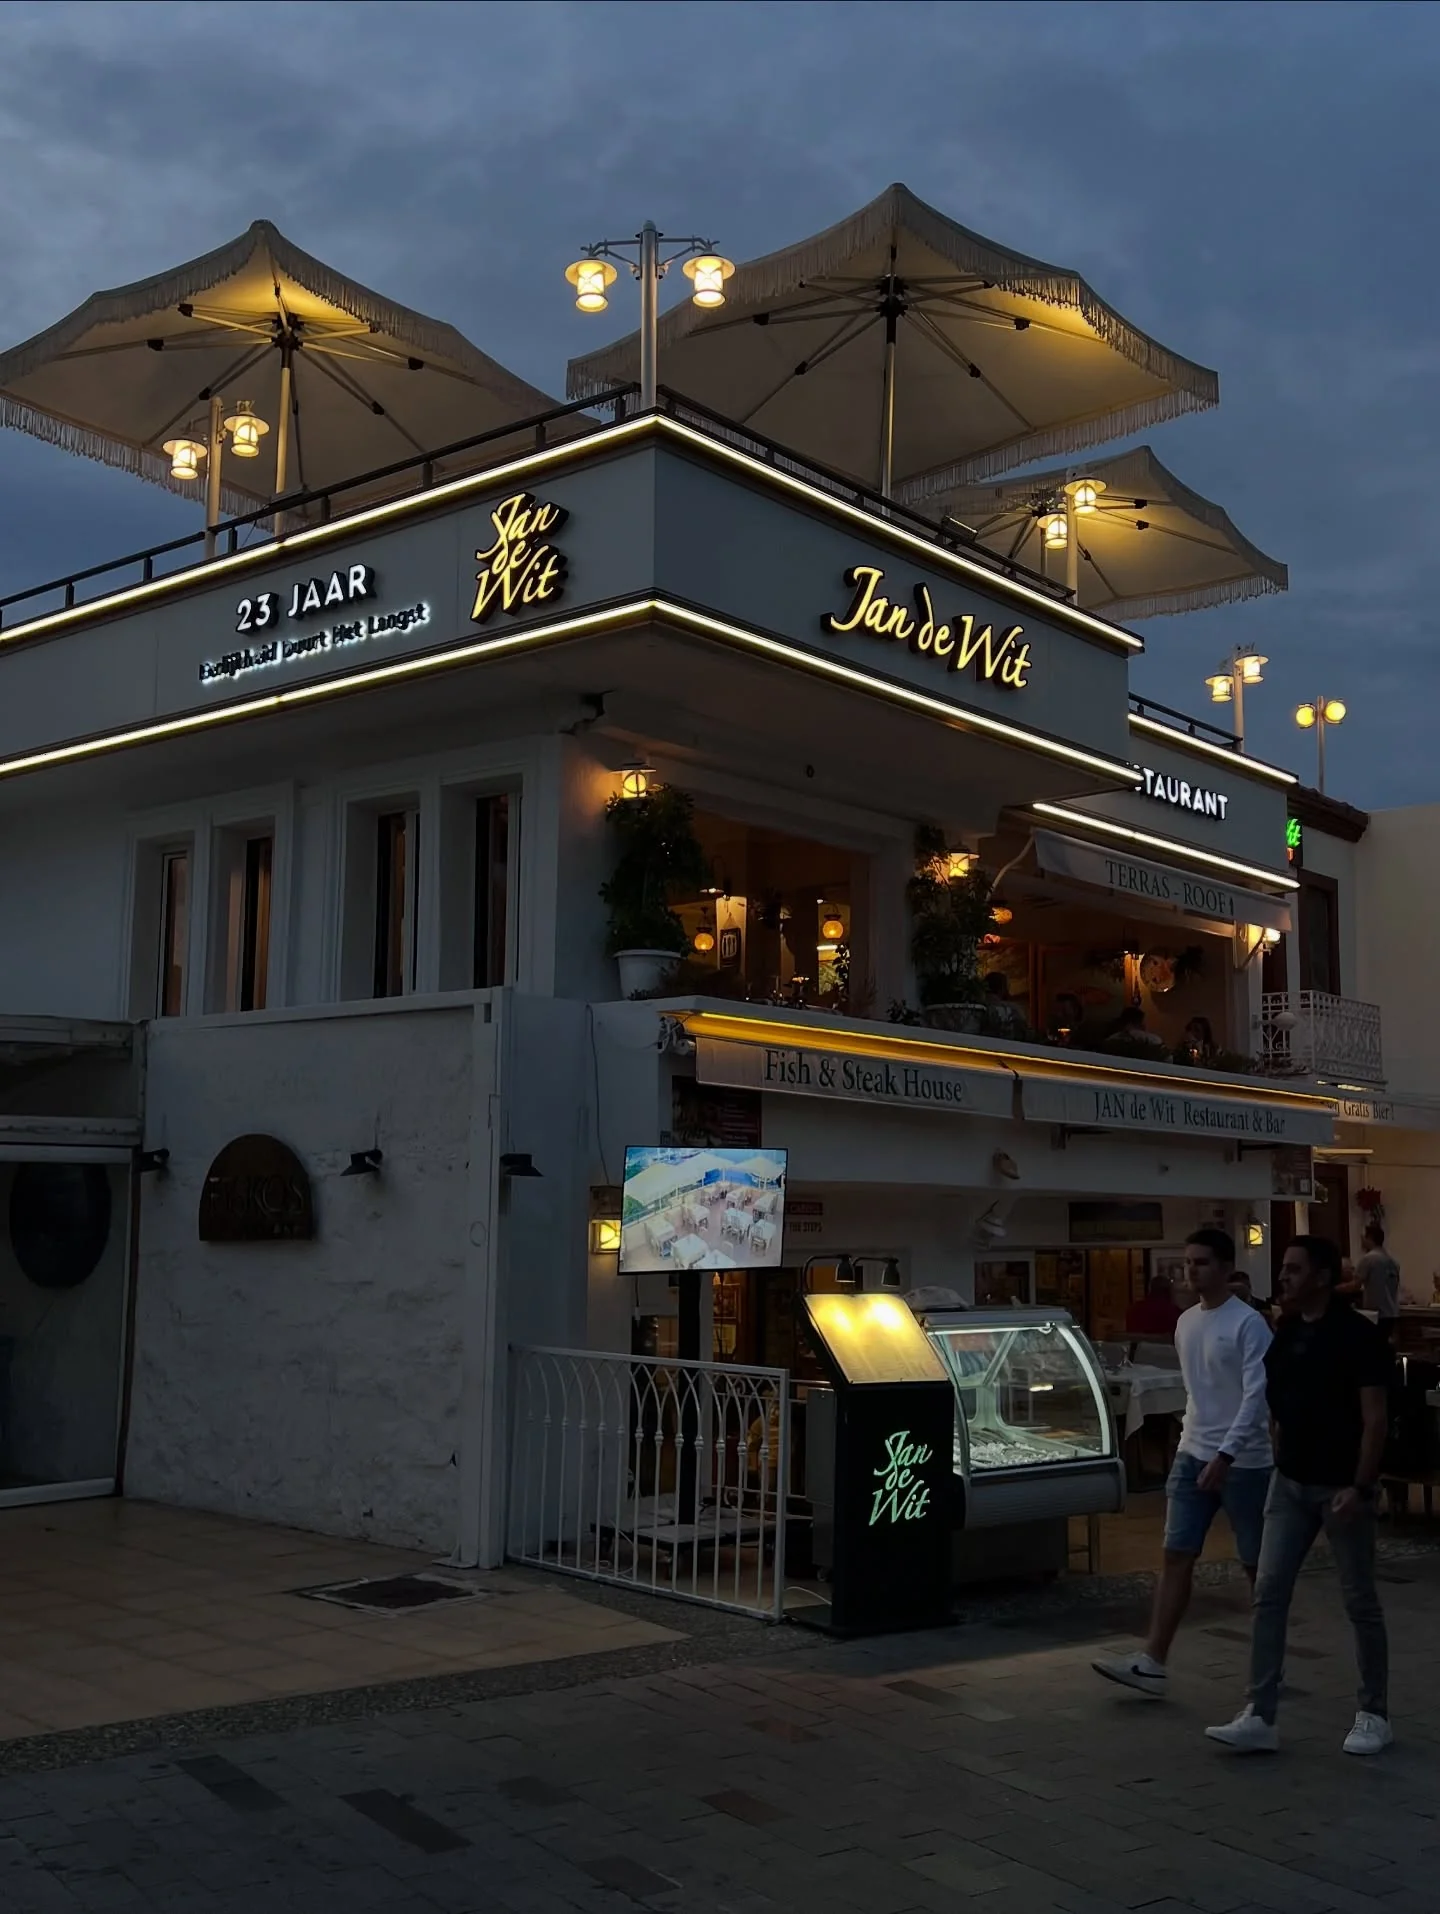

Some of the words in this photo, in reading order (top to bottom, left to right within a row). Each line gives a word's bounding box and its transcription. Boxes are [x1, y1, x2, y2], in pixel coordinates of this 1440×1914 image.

[475, 491, 558, 560] Jan
[235, 593, 271, 632] 23
[287, 563, 368, 618] JAAR
[471, 544, 558, 622] Wit
[332, 621, 363, 644] Het
[830, 566, 916, 640] Jan
[917, 585, 955, 657] de
[956, 614, 1032, 688] Wit
[1126, 763, 1229, 820] TAURANT
[1105, 859, 1170, 899] TERRAS
[764, 1049, 810, 1085] Fish
[818, 1058, 837, 1088] &
[842, 1059, 899, 1096] Steak
[903, 1067, 962, 1102] House
[1093, 1091, 1126, 1121] JAN
[1130, 1094, 1146, 1121] de
[1150, 1097, 1176, 1124] Wit
[1183, 1101, 1250, 1131] Restaurant
[1252, 1109, 1263, 1132] &
[1265, 1111, 1286, 1134] Bar
[872, 1430, 934, 1477] Jan
[868, 1479, 931, 1527] Wit
